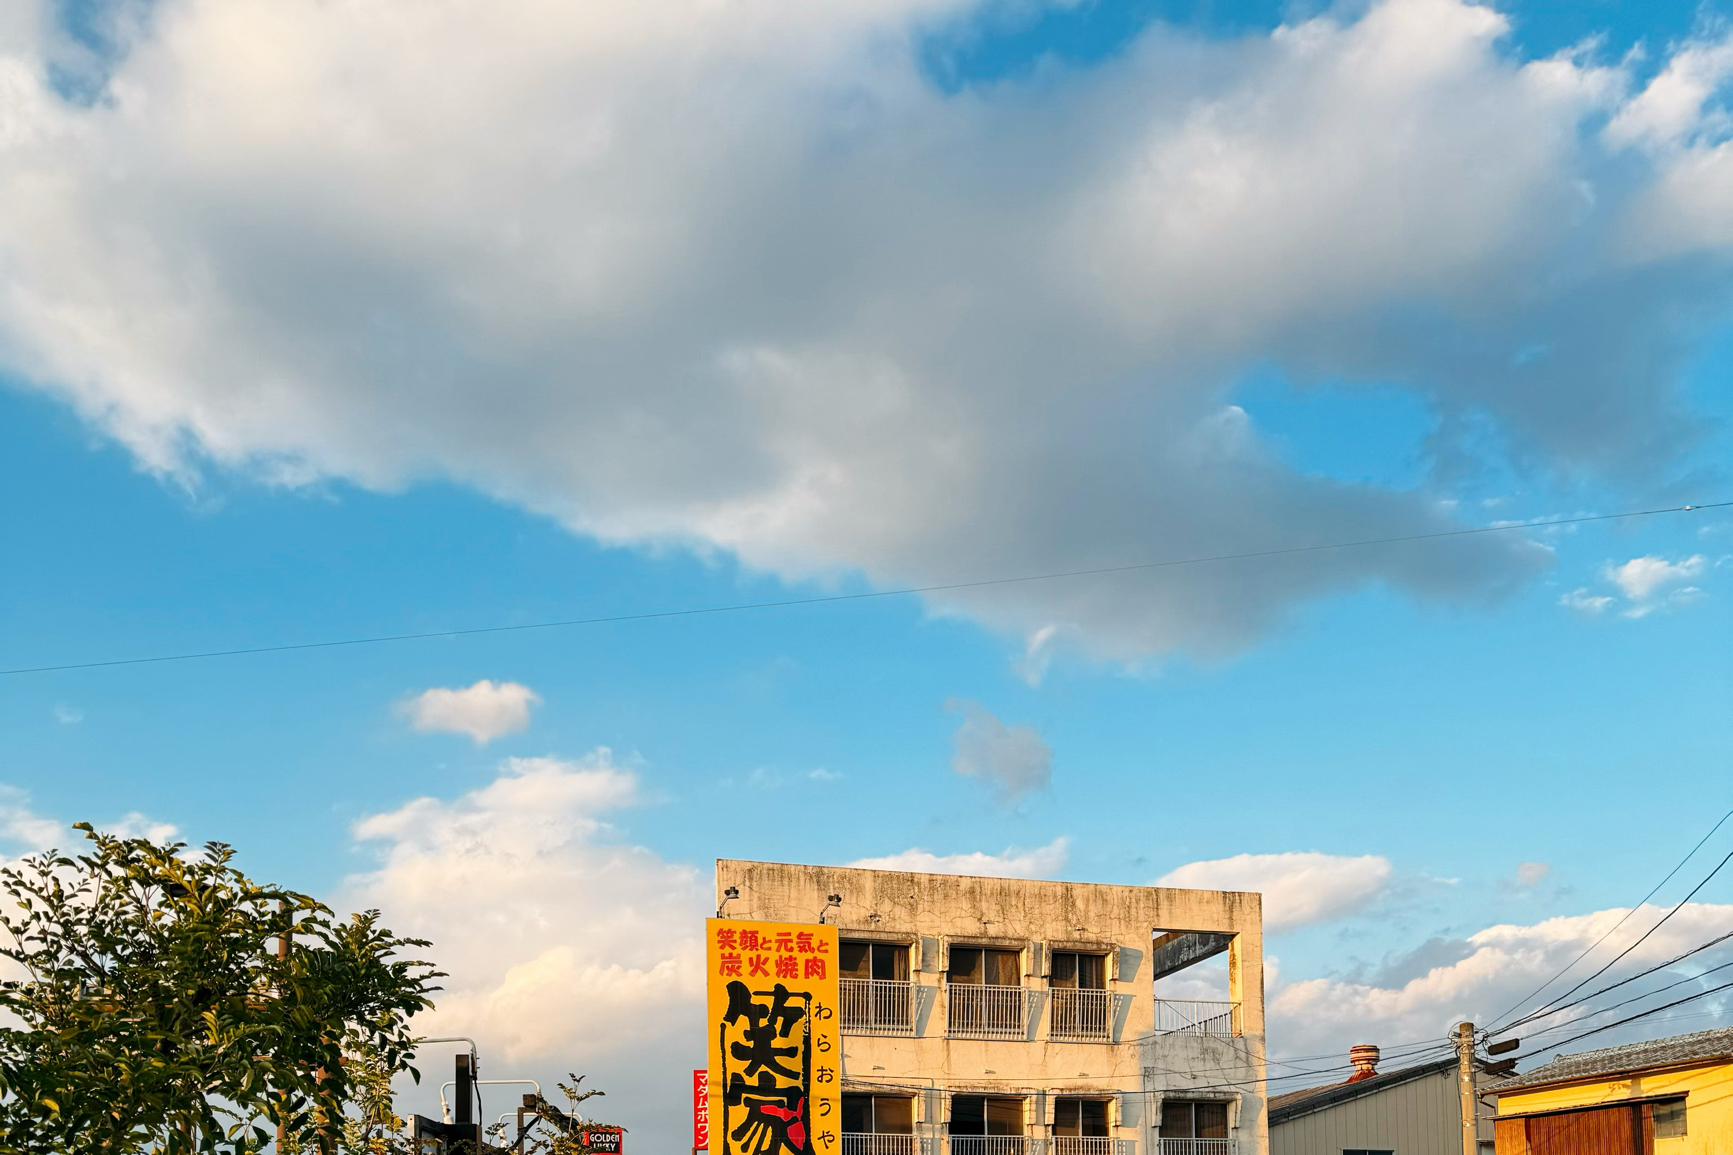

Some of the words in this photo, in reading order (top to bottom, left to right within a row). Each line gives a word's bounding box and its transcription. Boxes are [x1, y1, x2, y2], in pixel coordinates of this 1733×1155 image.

[716, 928, 829, 954] 笑顔と元気と
[718, 952, 826, 980] 炭火焼肉
[814, 1002, 835, 1149] わらおうや
[590, 1134, 619, 1142] GOLDEN
